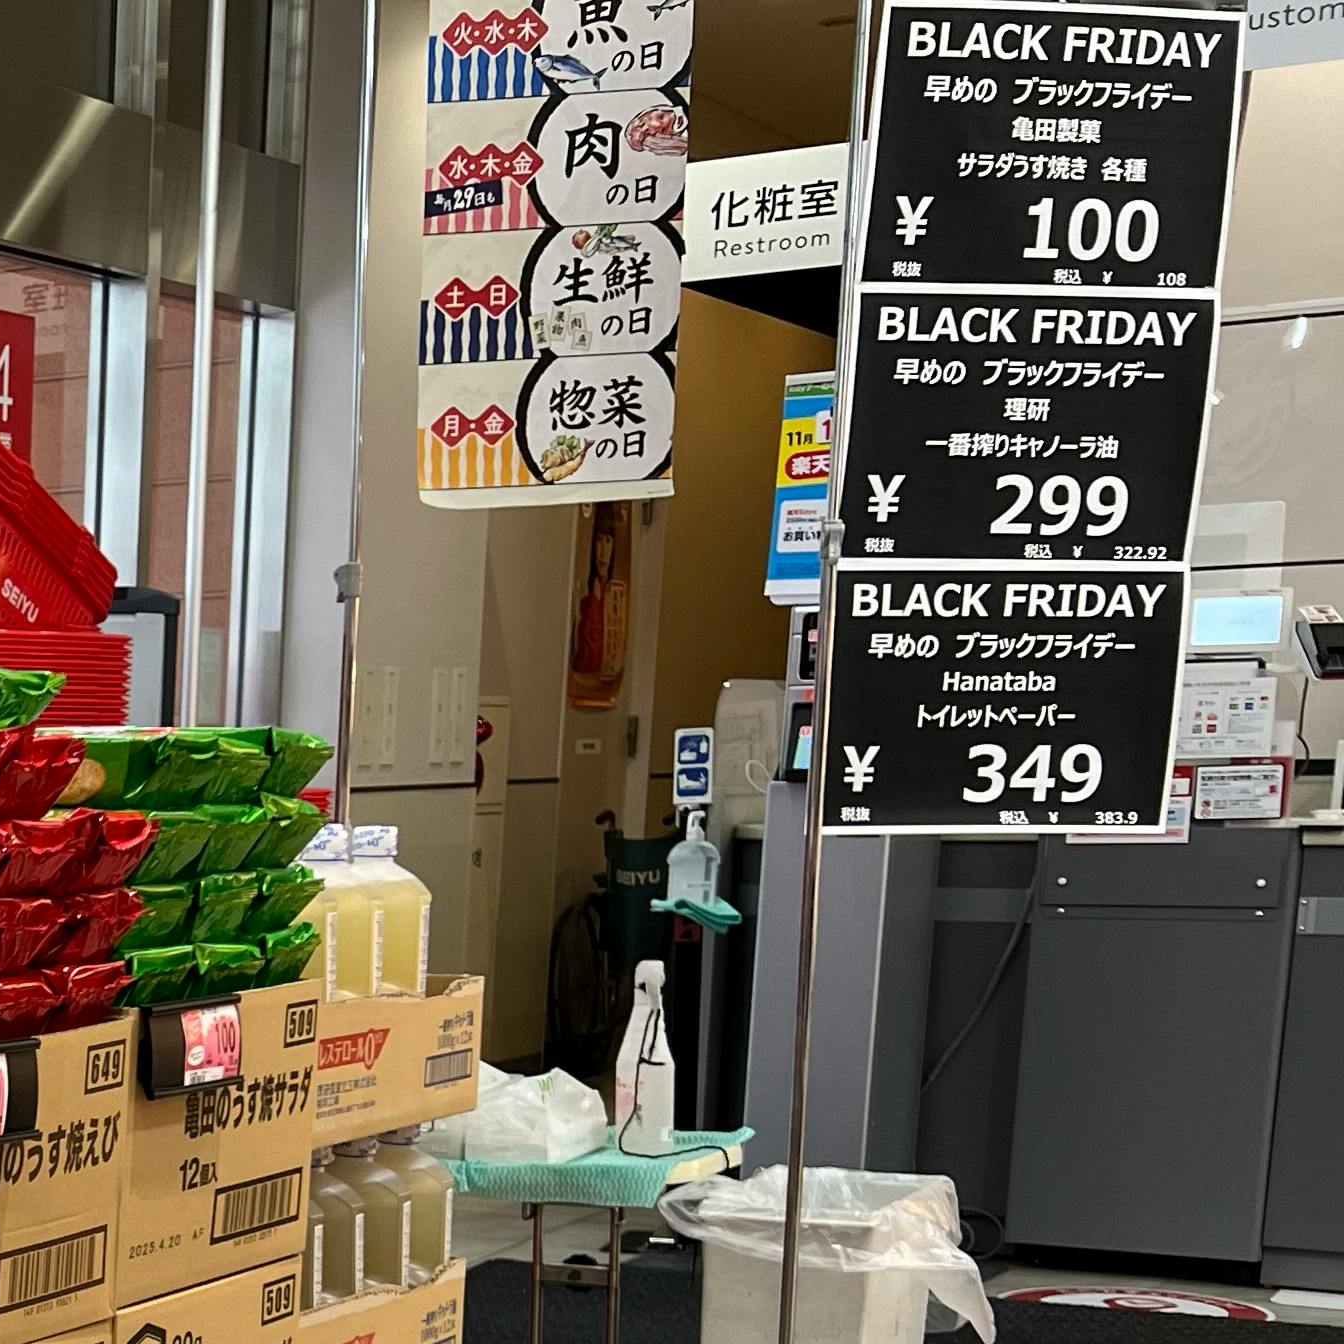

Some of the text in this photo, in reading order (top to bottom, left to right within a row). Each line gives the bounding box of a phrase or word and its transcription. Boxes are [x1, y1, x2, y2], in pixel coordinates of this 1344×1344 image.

[453, 14, 540, 47] 火・水・木
[907, 22, 1223, 69] BLACK FRIDAY
[611, 41, 665, 73] の日
[924, 75, 1193, 110] 早めの ブラックフライデー
[1011, 116, 1102, 144] 亀田製菓
[565, 113, 623, 180] 肉
[448, 150, 534, 179] 水・木・金
[957, 153, 1147, 184] サラダうす焼き 各種
[606, 175, 660, 206] の日
[711, 178, 839, 231] 化粧室
[713, 231, 832, 258] Restroom
[894, 196, 1160, 262] ¥ 100
[552, 252, 654, 307] 生鮮
[892, 261, 1187, 287] 税抜 税込 108
[600, 306, 653, 337] の日
[877, 307, 1197, 347] BLACK FRIDAY
[893, 358, 1165, 389] 早めの ブラックフライデー
[549, 377, 647, 432] 惣菜
[1003, 397, 1050, 422] 理研
[443, 412, 505, 437] 月・金
[595, 429, 646, 460] の日
[925, 432, 1120, 459] 一番搾りキャノーラ油
[866, 474, 1130, 536] ¥ 299
[864, 537, 1168, 561] 税抜 税込 322.92
[0, 577, 41, 623] SEIYU
[852, 583, 1167, 618] BLACK FRIDAY
[868, 632, 1136, 660] 早めの ブラックフライデー
[942, 671, 1056, 692] Hanataba
[916, 704, 1076, 729] トイレットペーパー
[842, 743, 1104, 804] ¥ 349
[840, 806, 1139, 825] 税抜 税込 383.9
[215, 1021, 236, 1055] 100
[288, 1009, 313, 1039] 509
[90, 1051, 121, 1084] 649
[184, 1065, 314, 1141] 亀田のうす焼サラダ
[178, 1156, 219, 1192] 12個入
[128, 1233, 182, 1260] 2025.4.20
[264, 1282, 292, 1317] 509
